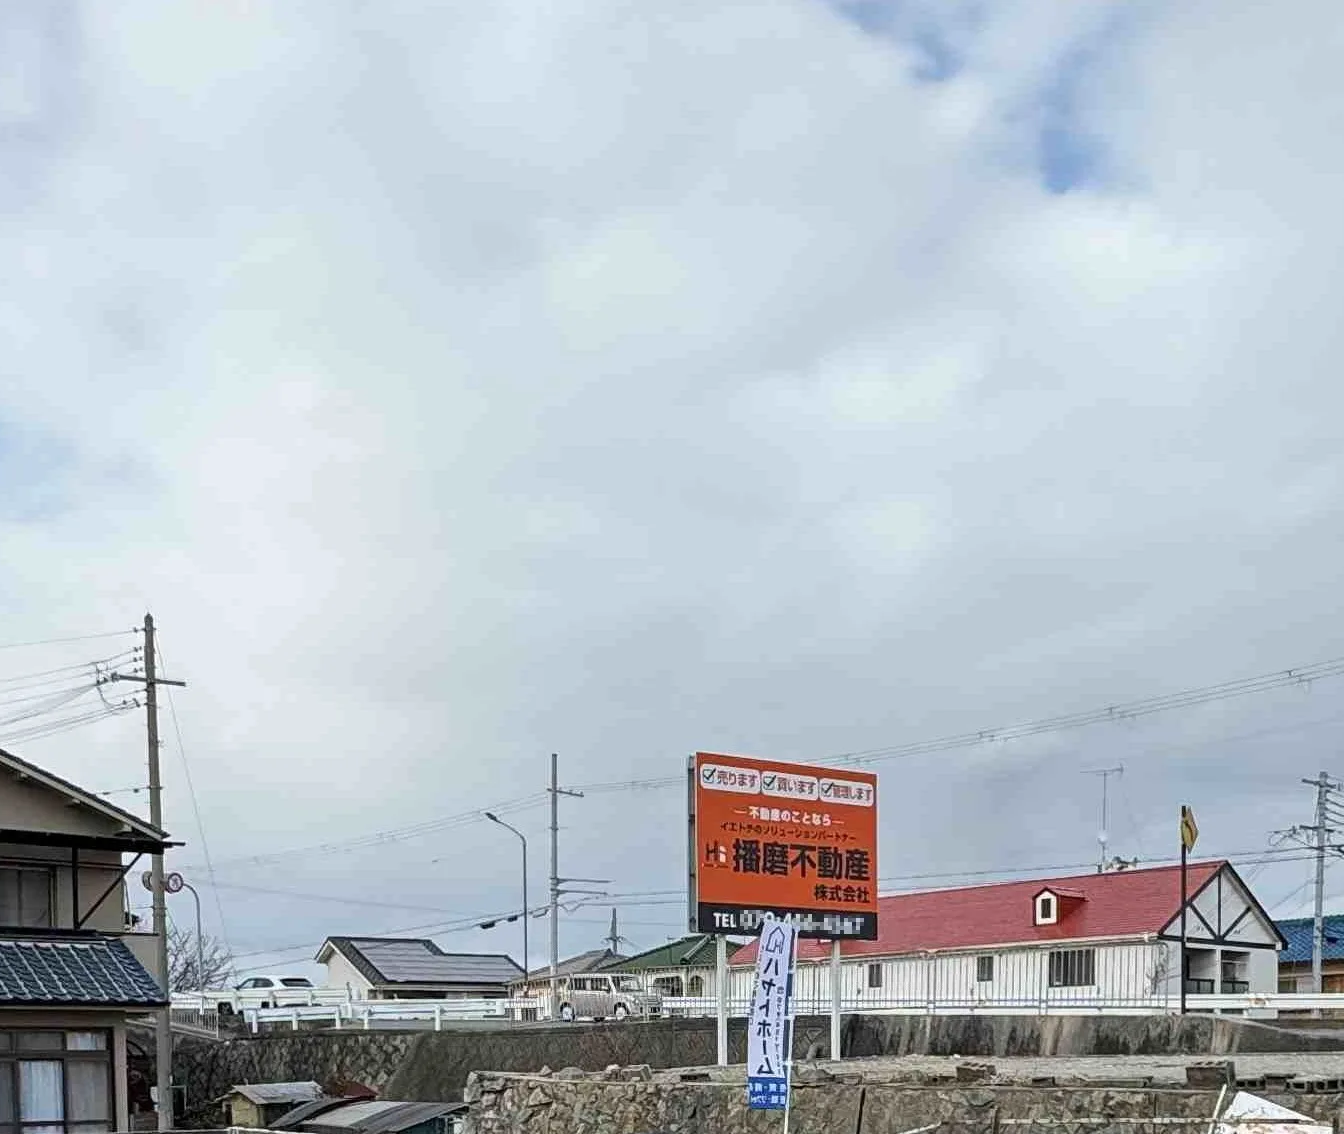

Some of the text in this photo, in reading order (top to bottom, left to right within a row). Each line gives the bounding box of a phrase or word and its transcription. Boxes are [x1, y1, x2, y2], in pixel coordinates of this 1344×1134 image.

[717, 770, 758, 788] 売ります
[777, 777, 817, 795] 買います
[732, 839, 871, 881] 播磨不動産
[814, 884, 871, 904] 株式会社
[713, 912, 737, 928] TEL
